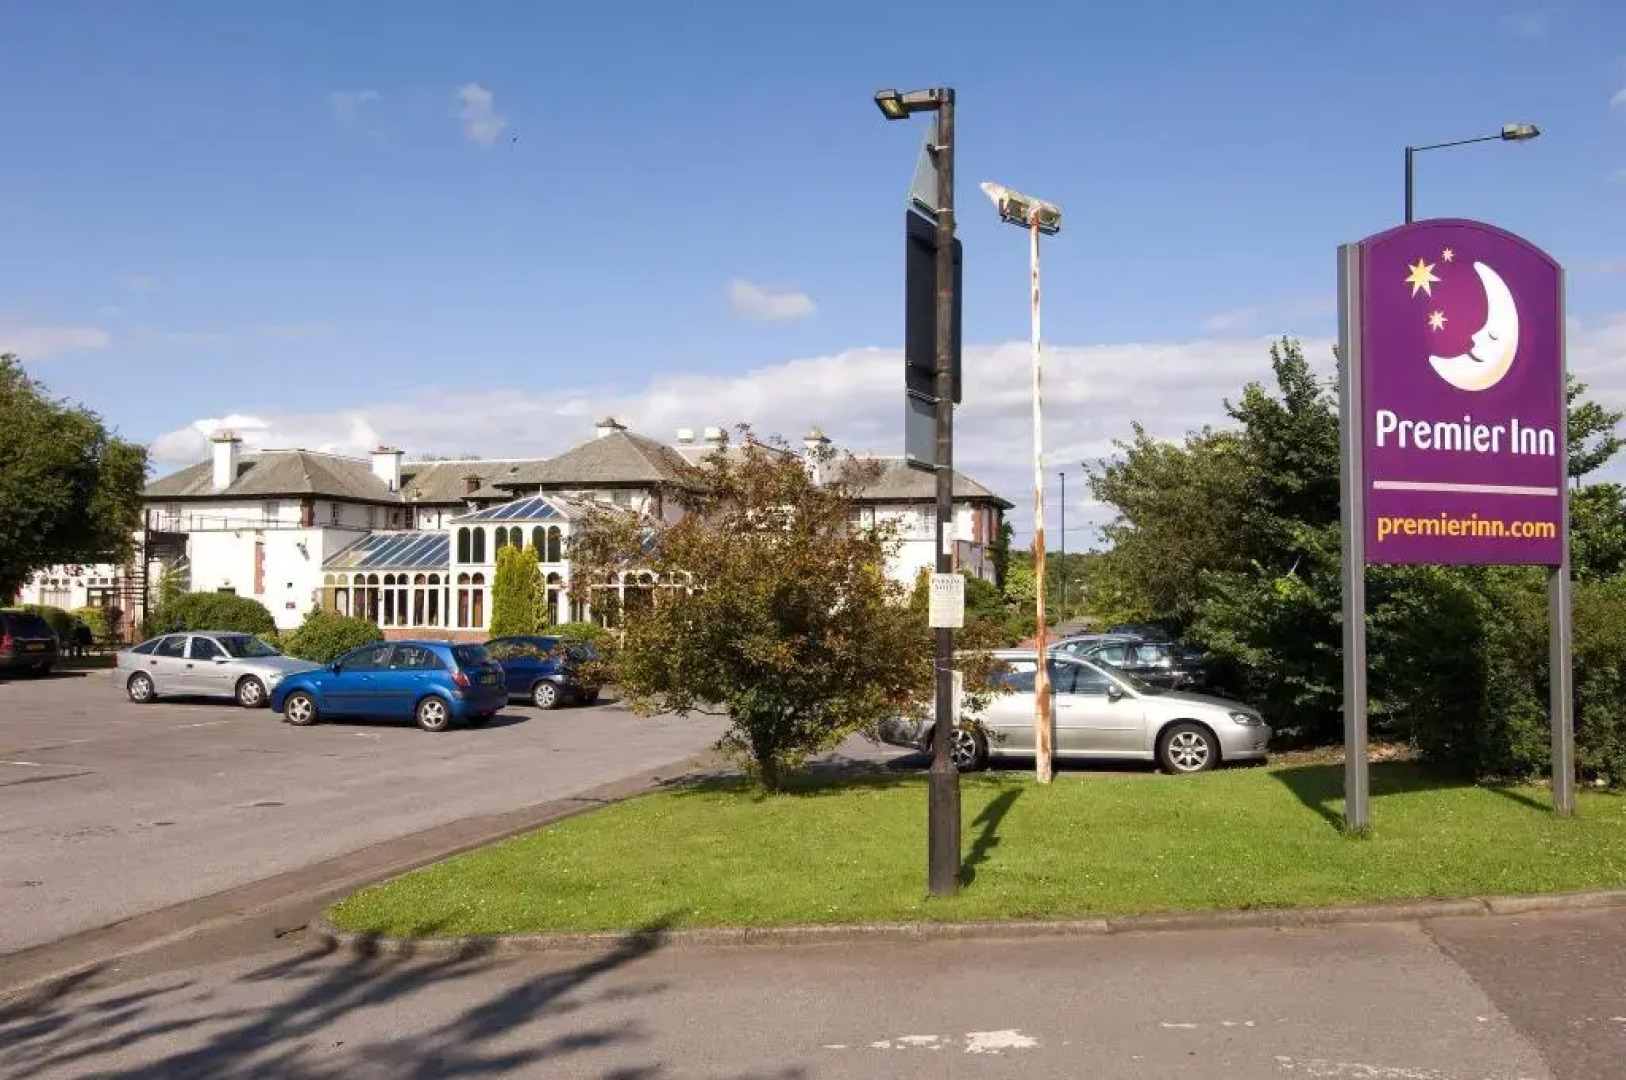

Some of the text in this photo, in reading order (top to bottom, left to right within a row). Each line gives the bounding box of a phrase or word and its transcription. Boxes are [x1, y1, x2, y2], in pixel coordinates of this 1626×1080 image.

[1376, 409, 1555, 456] Premier Inn
[1377, 512, 1555, 542] premierinn.com
